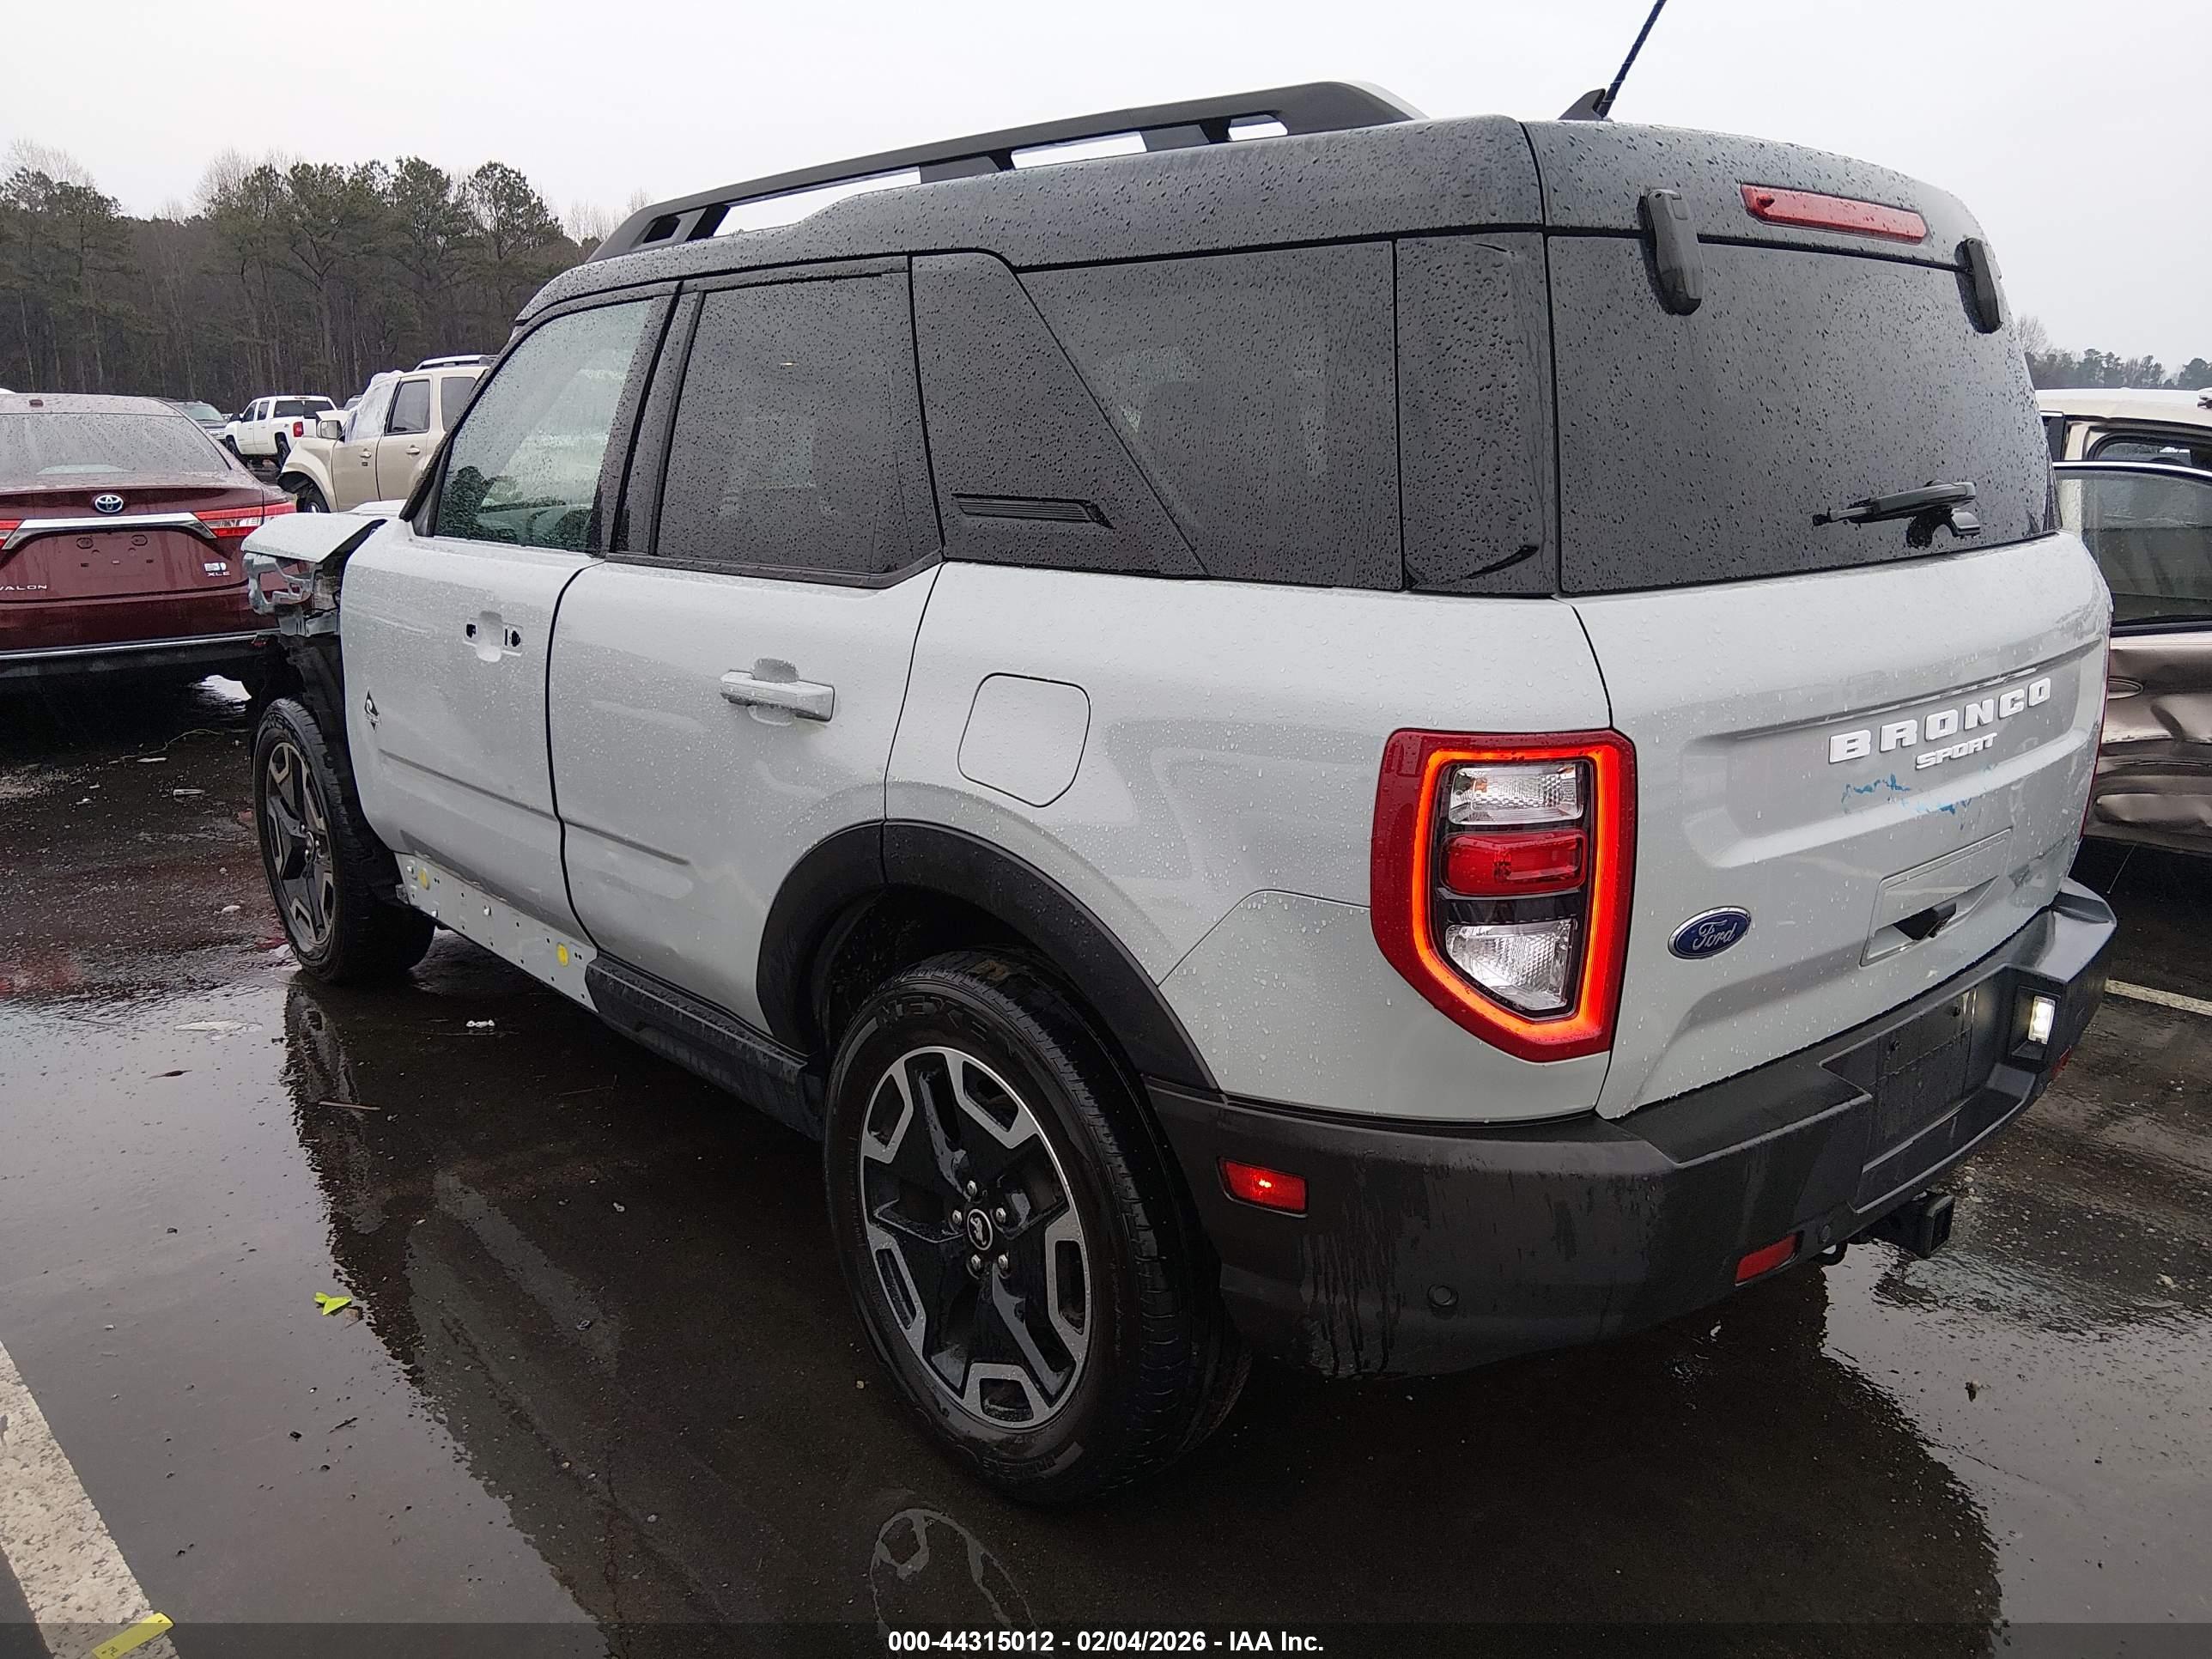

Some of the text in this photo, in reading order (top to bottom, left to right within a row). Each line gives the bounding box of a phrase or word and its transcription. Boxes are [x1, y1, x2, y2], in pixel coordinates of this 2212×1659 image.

[1829, 678, 2051, 763] BRONCO
[1916, 732, 1998, 769] SPORT
[1692, 919, 1738, 951] Ford
